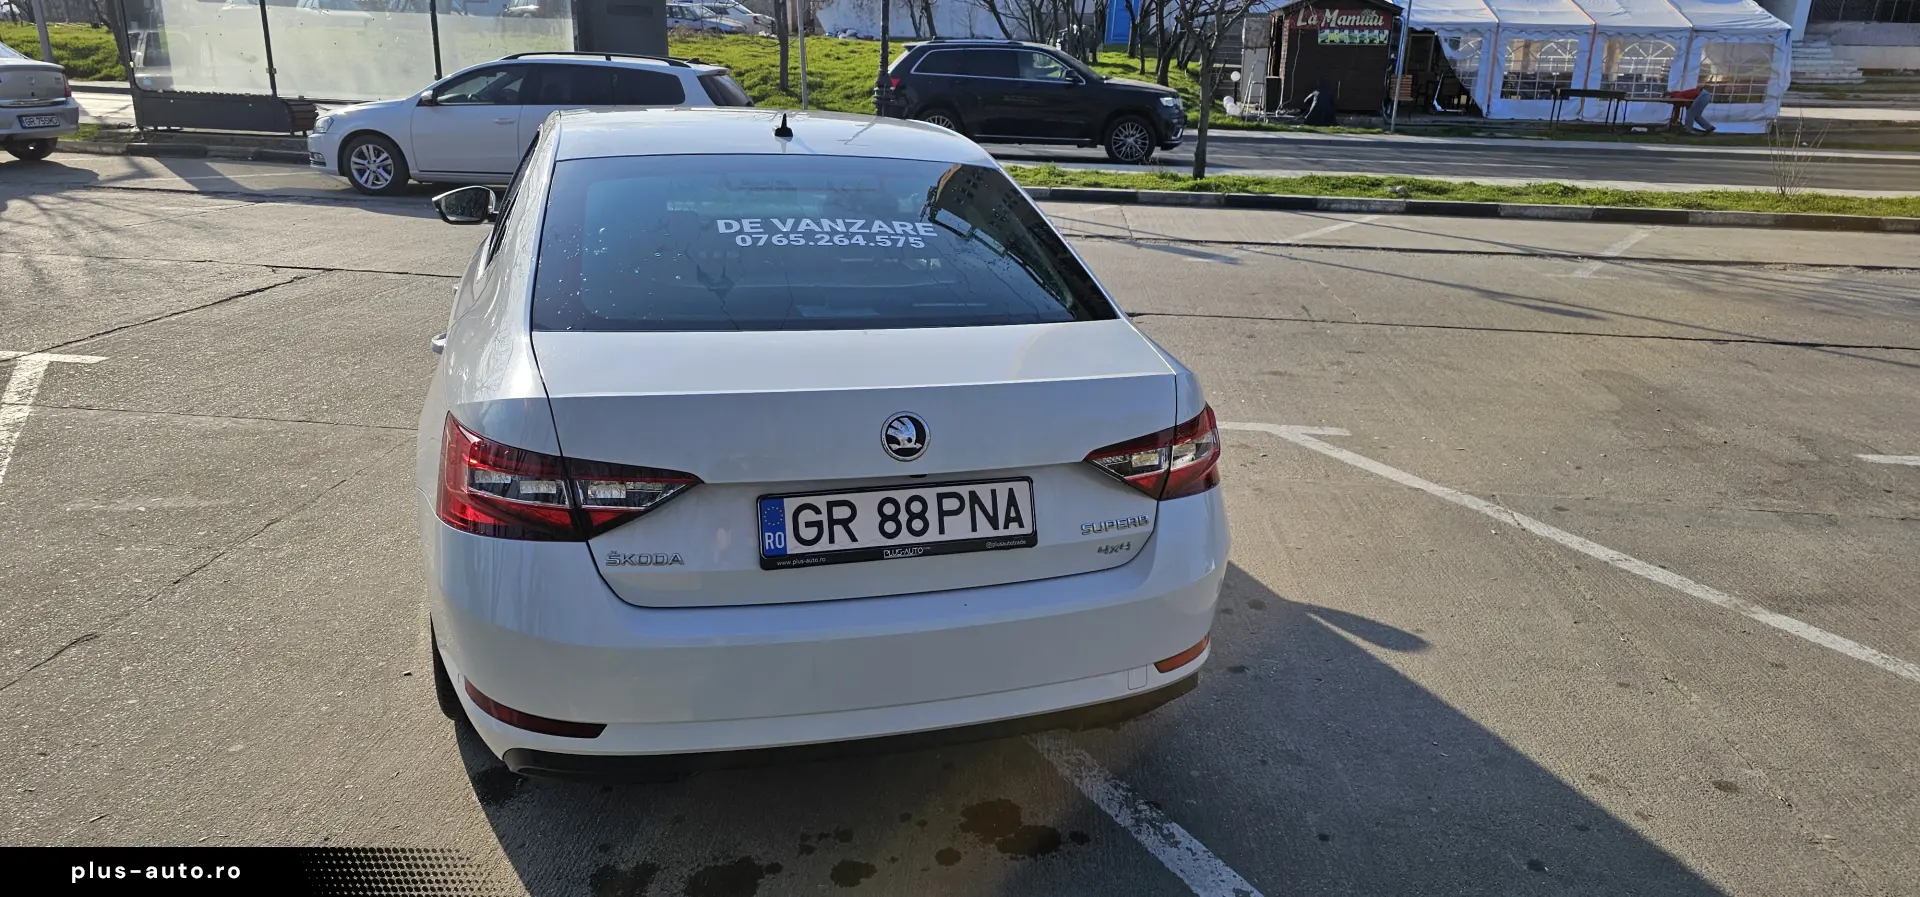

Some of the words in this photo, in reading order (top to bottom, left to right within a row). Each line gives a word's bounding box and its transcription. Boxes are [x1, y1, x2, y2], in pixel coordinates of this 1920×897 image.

[1296, 8, 1318, 27] La
[24, 117, 36, 126] GR
[716, 218, 764, 234] DE
[770, 218, 938, 237] VANZARE
[735, 233, 926, 249] 0765.264.575
[792, 499, 859, 547] GR
[1081, 514, 1150, 536] SUPERB
[764, 531, 785, 550] RO
[605, 550, 685, 566] ŠKODA
[776, 557, 827, 566] www.plus-auto.ro
